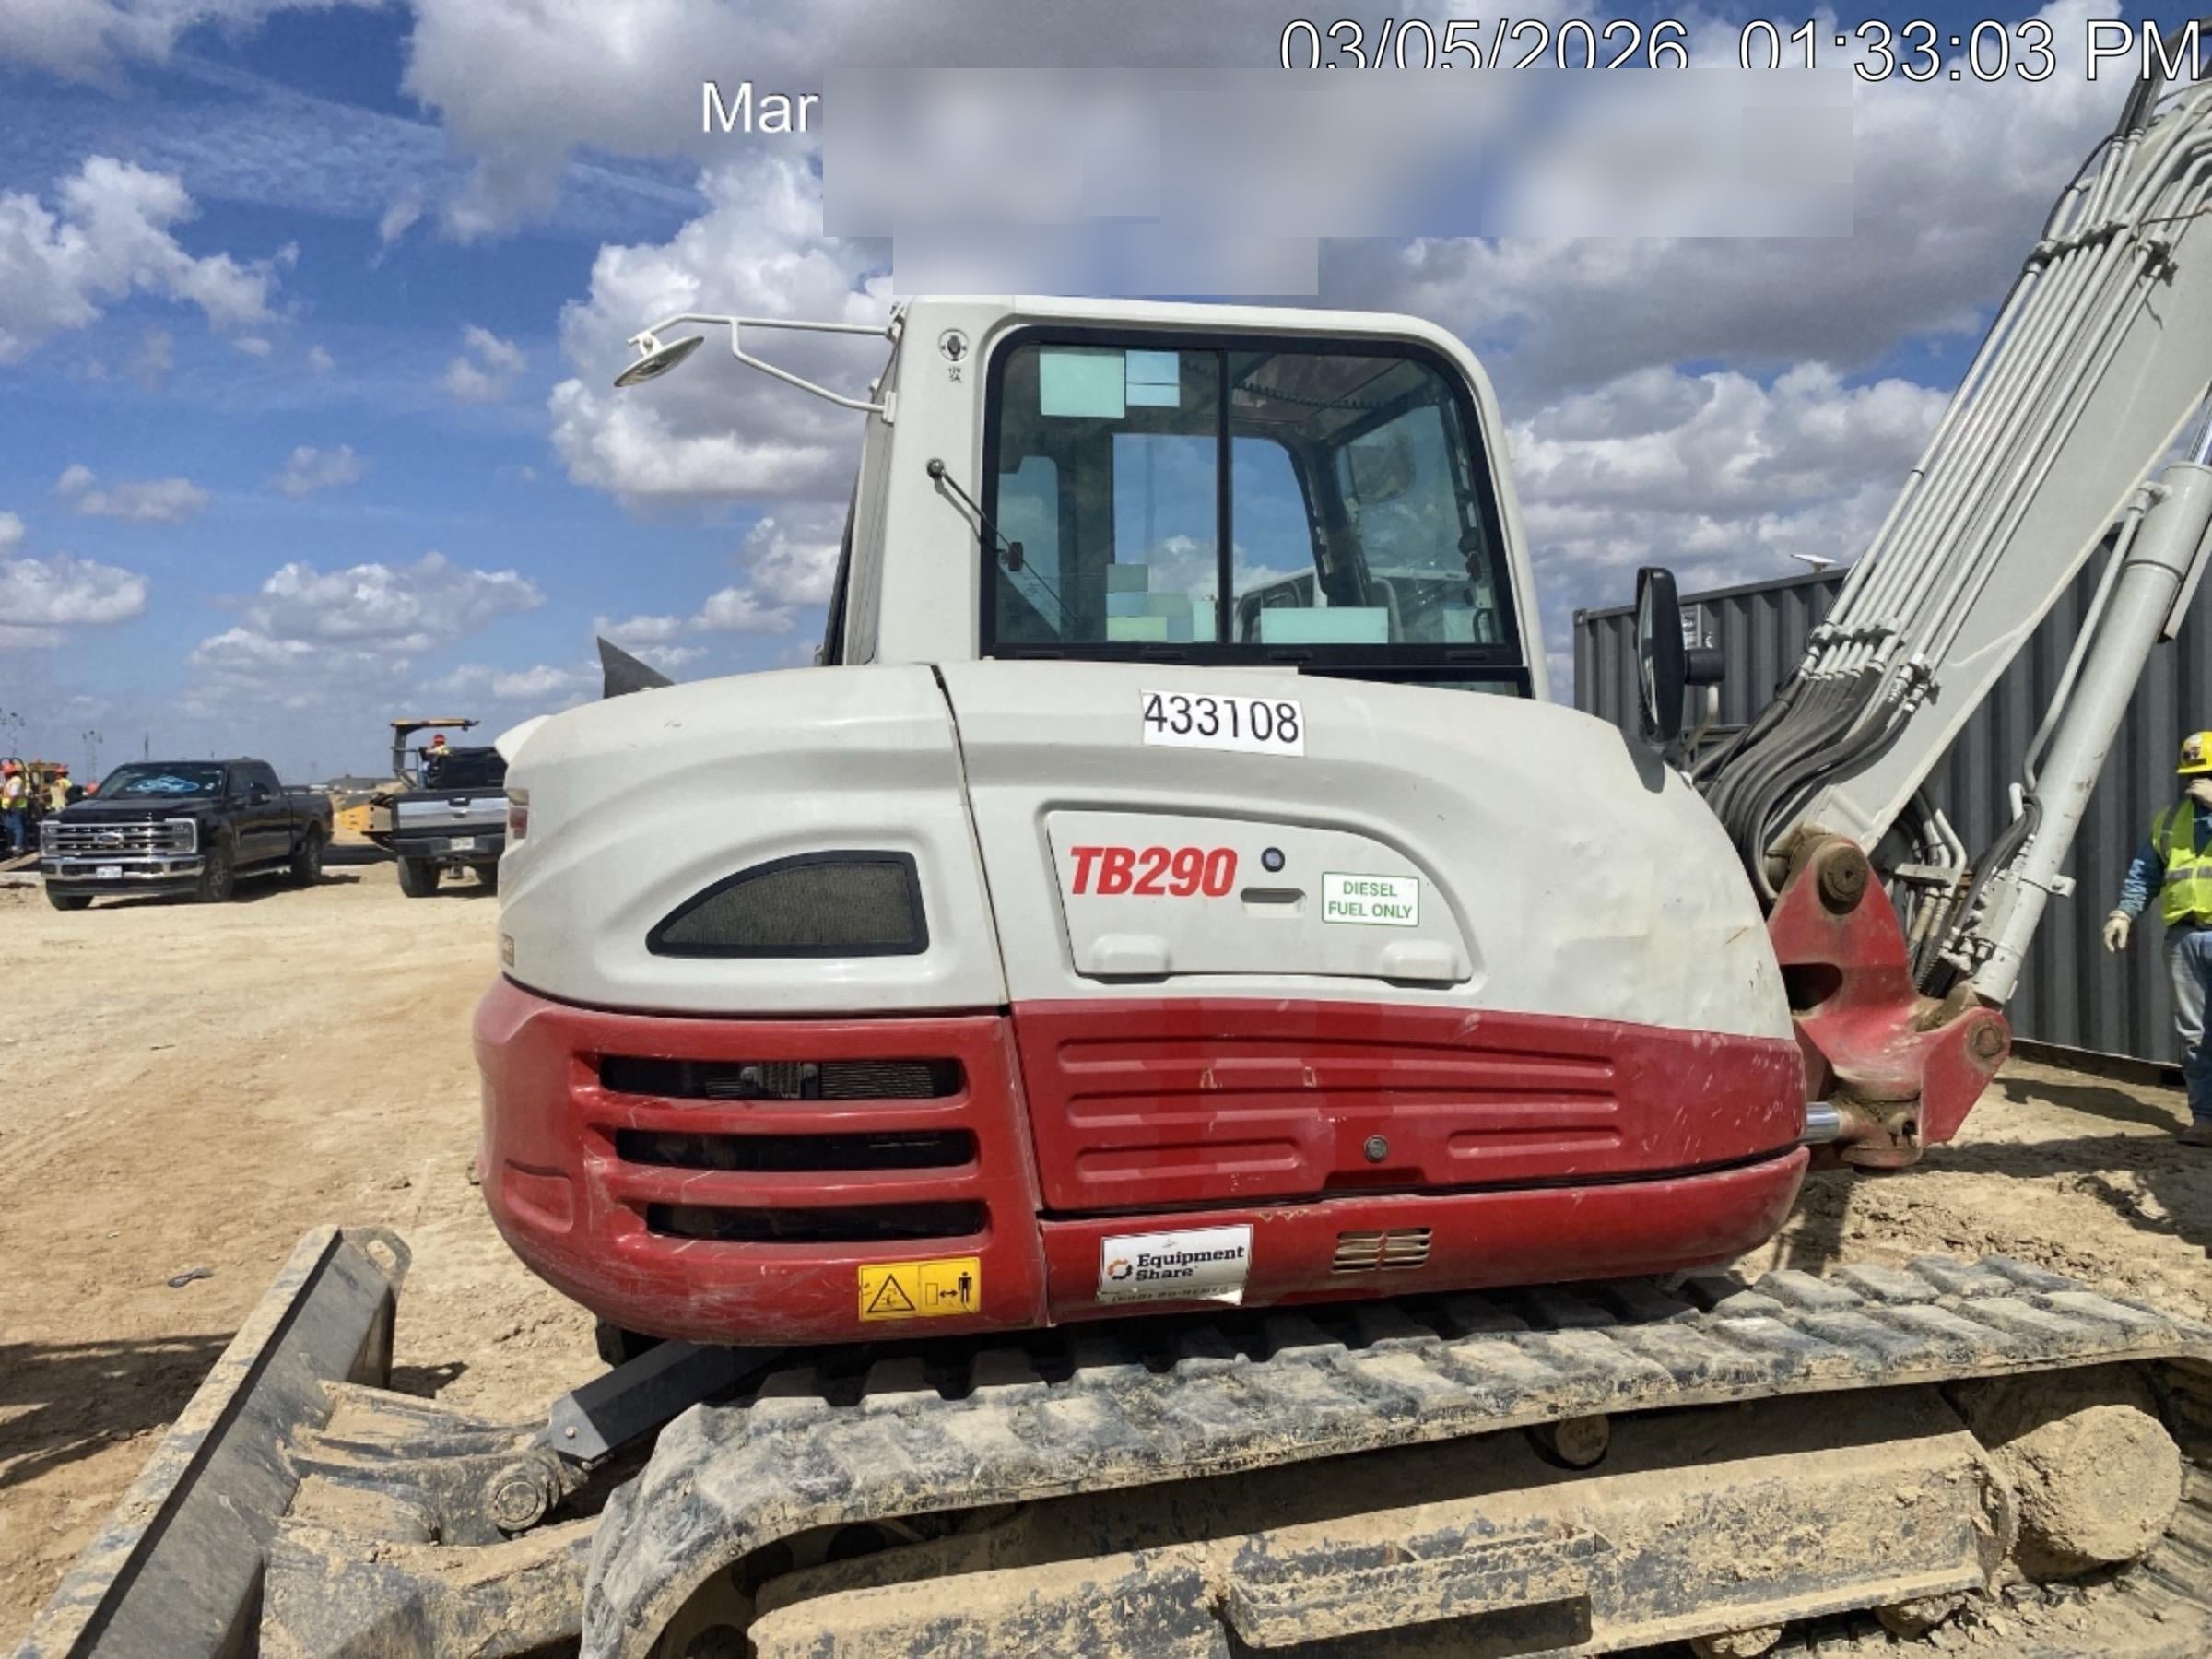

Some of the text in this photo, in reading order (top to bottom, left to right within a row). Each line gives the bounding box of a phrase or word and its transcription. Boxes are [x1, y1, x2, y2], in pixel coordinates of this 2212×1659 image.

[1143, 694, 1300, 743] 433108
[1070, 846, 1238, 897] TB290
[1343, 881, 1398, 897] DIESEL
[1328, 900, 1412, 919] FUEL ONLY
[1136, 1245, 1244, 1268] Equipment
[1135, 1266, 1194, 1281] Share
